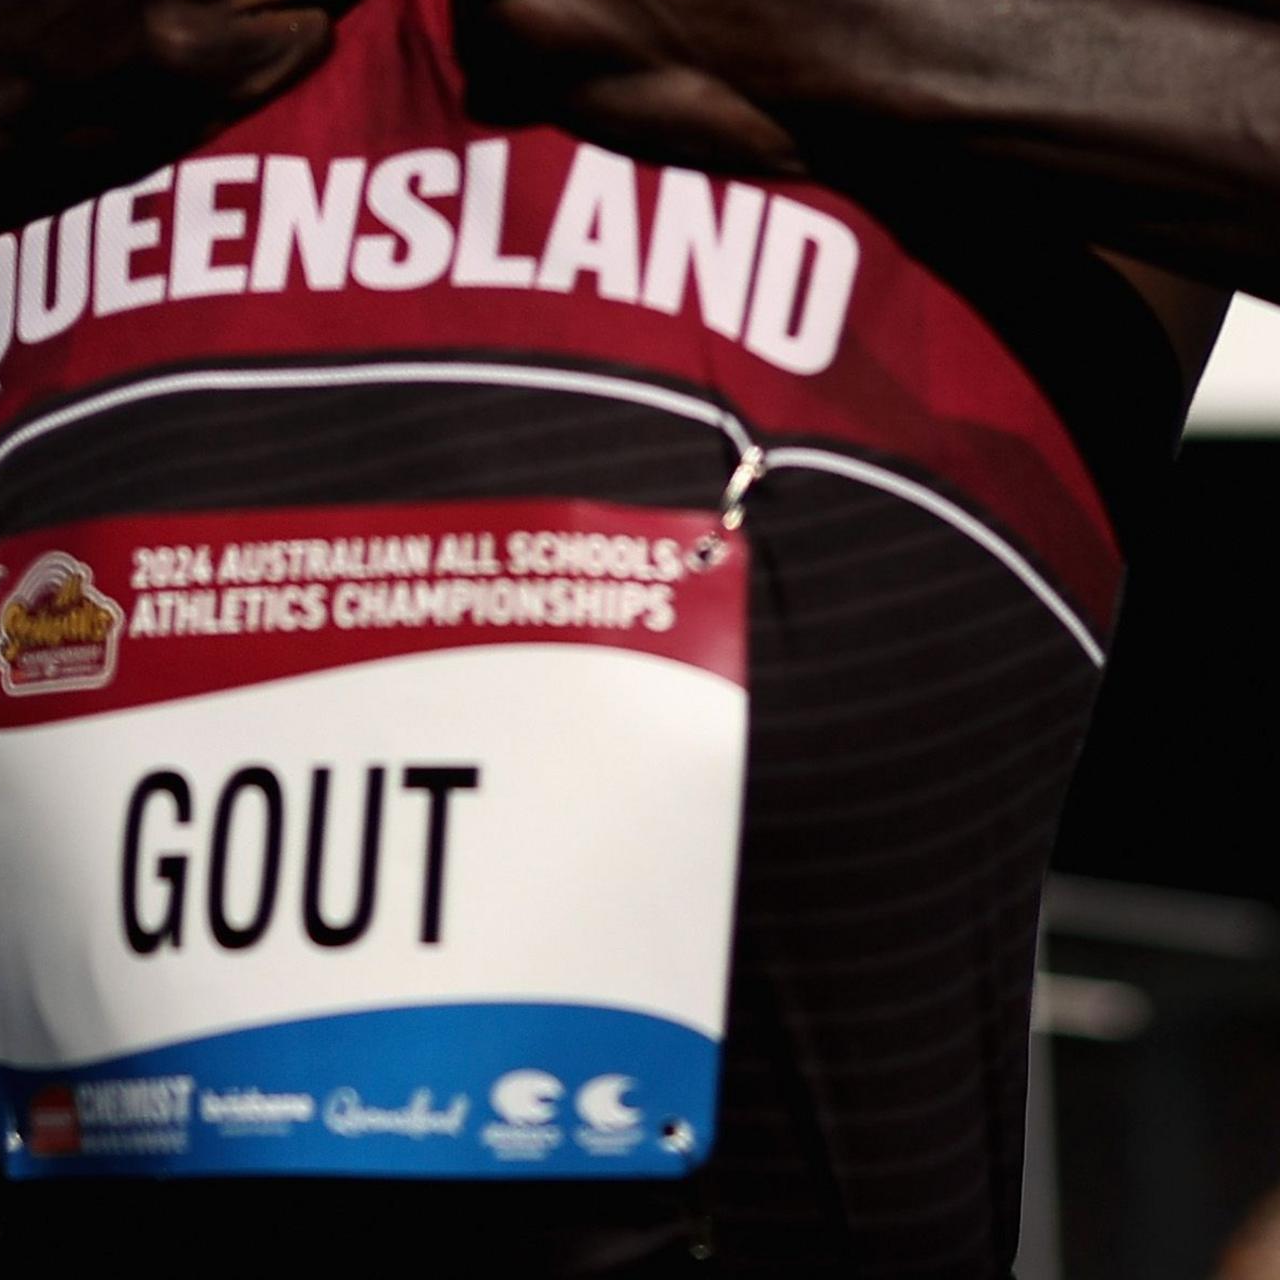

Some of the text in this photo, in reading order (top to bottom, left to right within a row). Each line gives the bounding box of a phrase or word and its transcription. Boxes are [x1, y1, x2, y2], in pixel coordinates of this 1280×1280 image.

[132, 531, 682, 588] 2024 AUSTRALIAN ALL SCHOOLS
[129, 585, 328, 637] ATHLETICS
[334, 578, 674, 631] CHAMPIONSHIPS
[122, 767, 479, 954] GOUT
